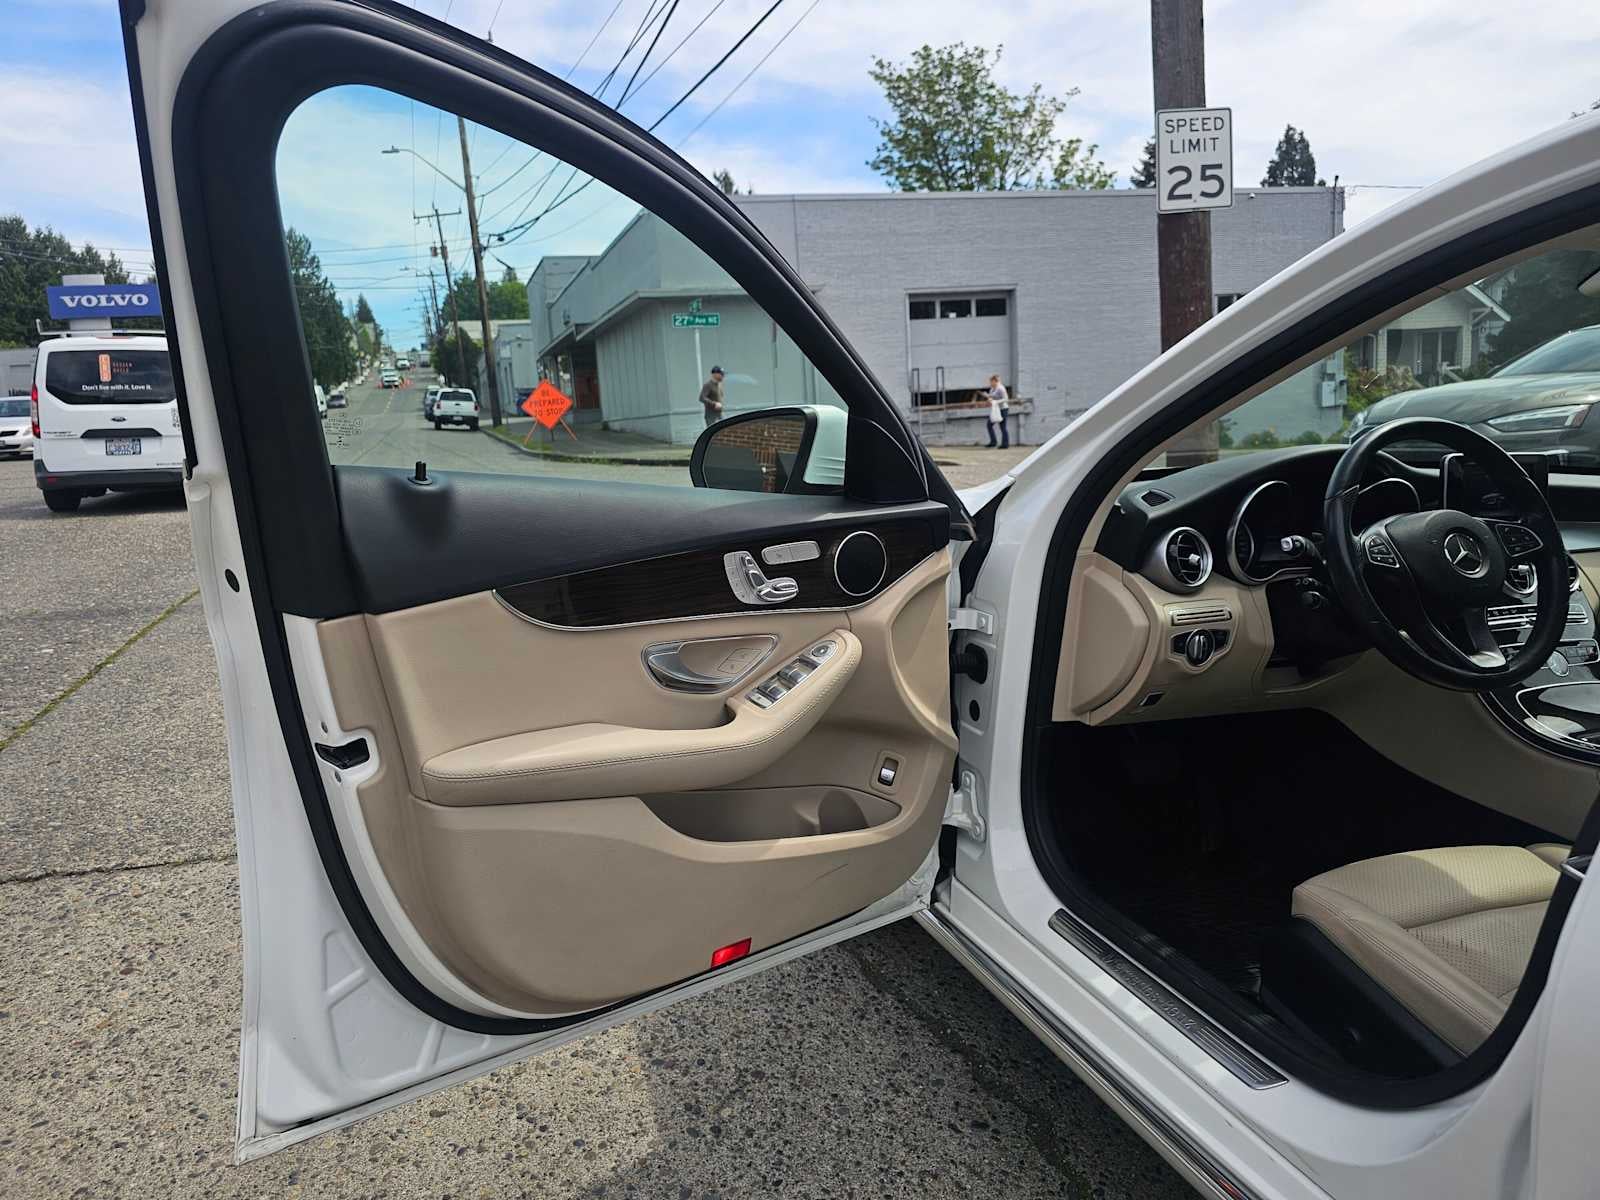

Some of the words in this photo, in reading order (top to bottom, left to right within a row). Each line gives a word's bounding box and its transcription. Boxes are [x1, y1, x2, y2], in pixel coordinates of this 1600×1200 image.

[1165, 117, 1225, 133] SPEED
[1170, 137, 1220, 154] LIMIT
[1167, 163, 1225, 201] 25
[60, 294, 149, 307] VOLVO
[529, 398, 565, 408] PREPARED
[546, 407, 563, 417] STOP
